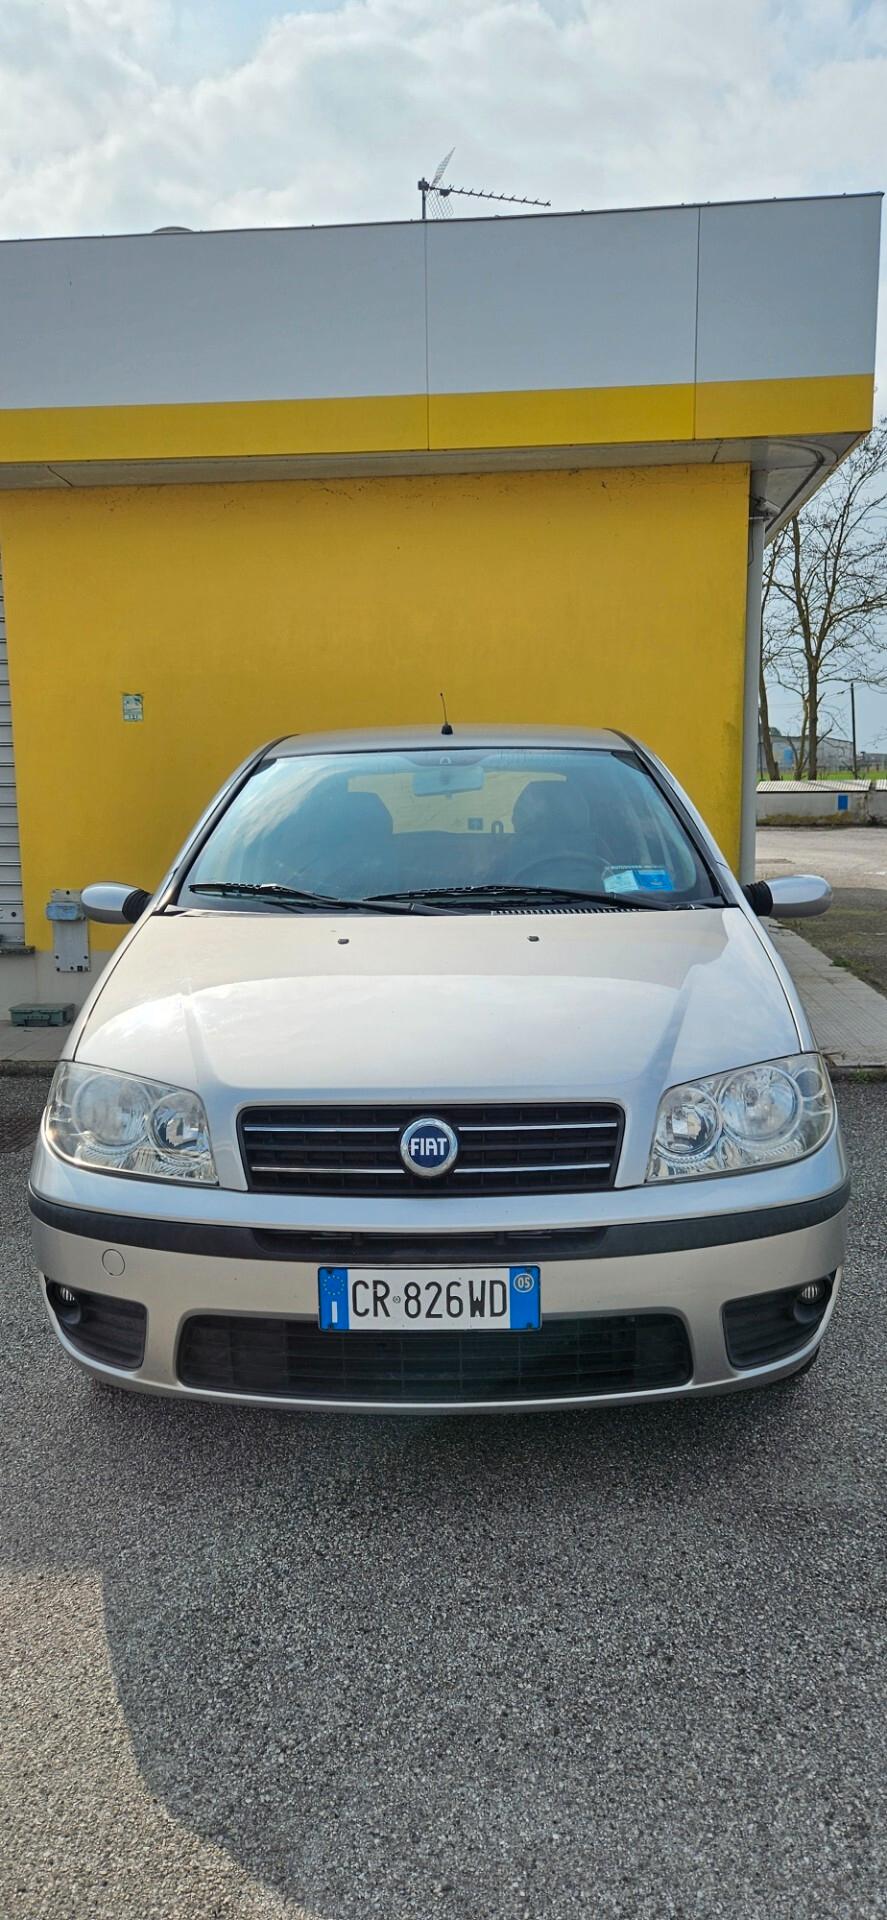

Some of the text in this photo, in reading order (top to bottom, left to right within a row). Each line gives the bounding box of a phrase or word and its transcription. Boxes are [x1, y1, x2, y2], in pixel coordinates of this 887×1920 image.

[410, 1137, 447, 1156] FIAT
[517, 1277, 531, 1289] 05
[351, 1280, 507, 1319] CR 826WD
[331, 1301, 338, 1323] I
